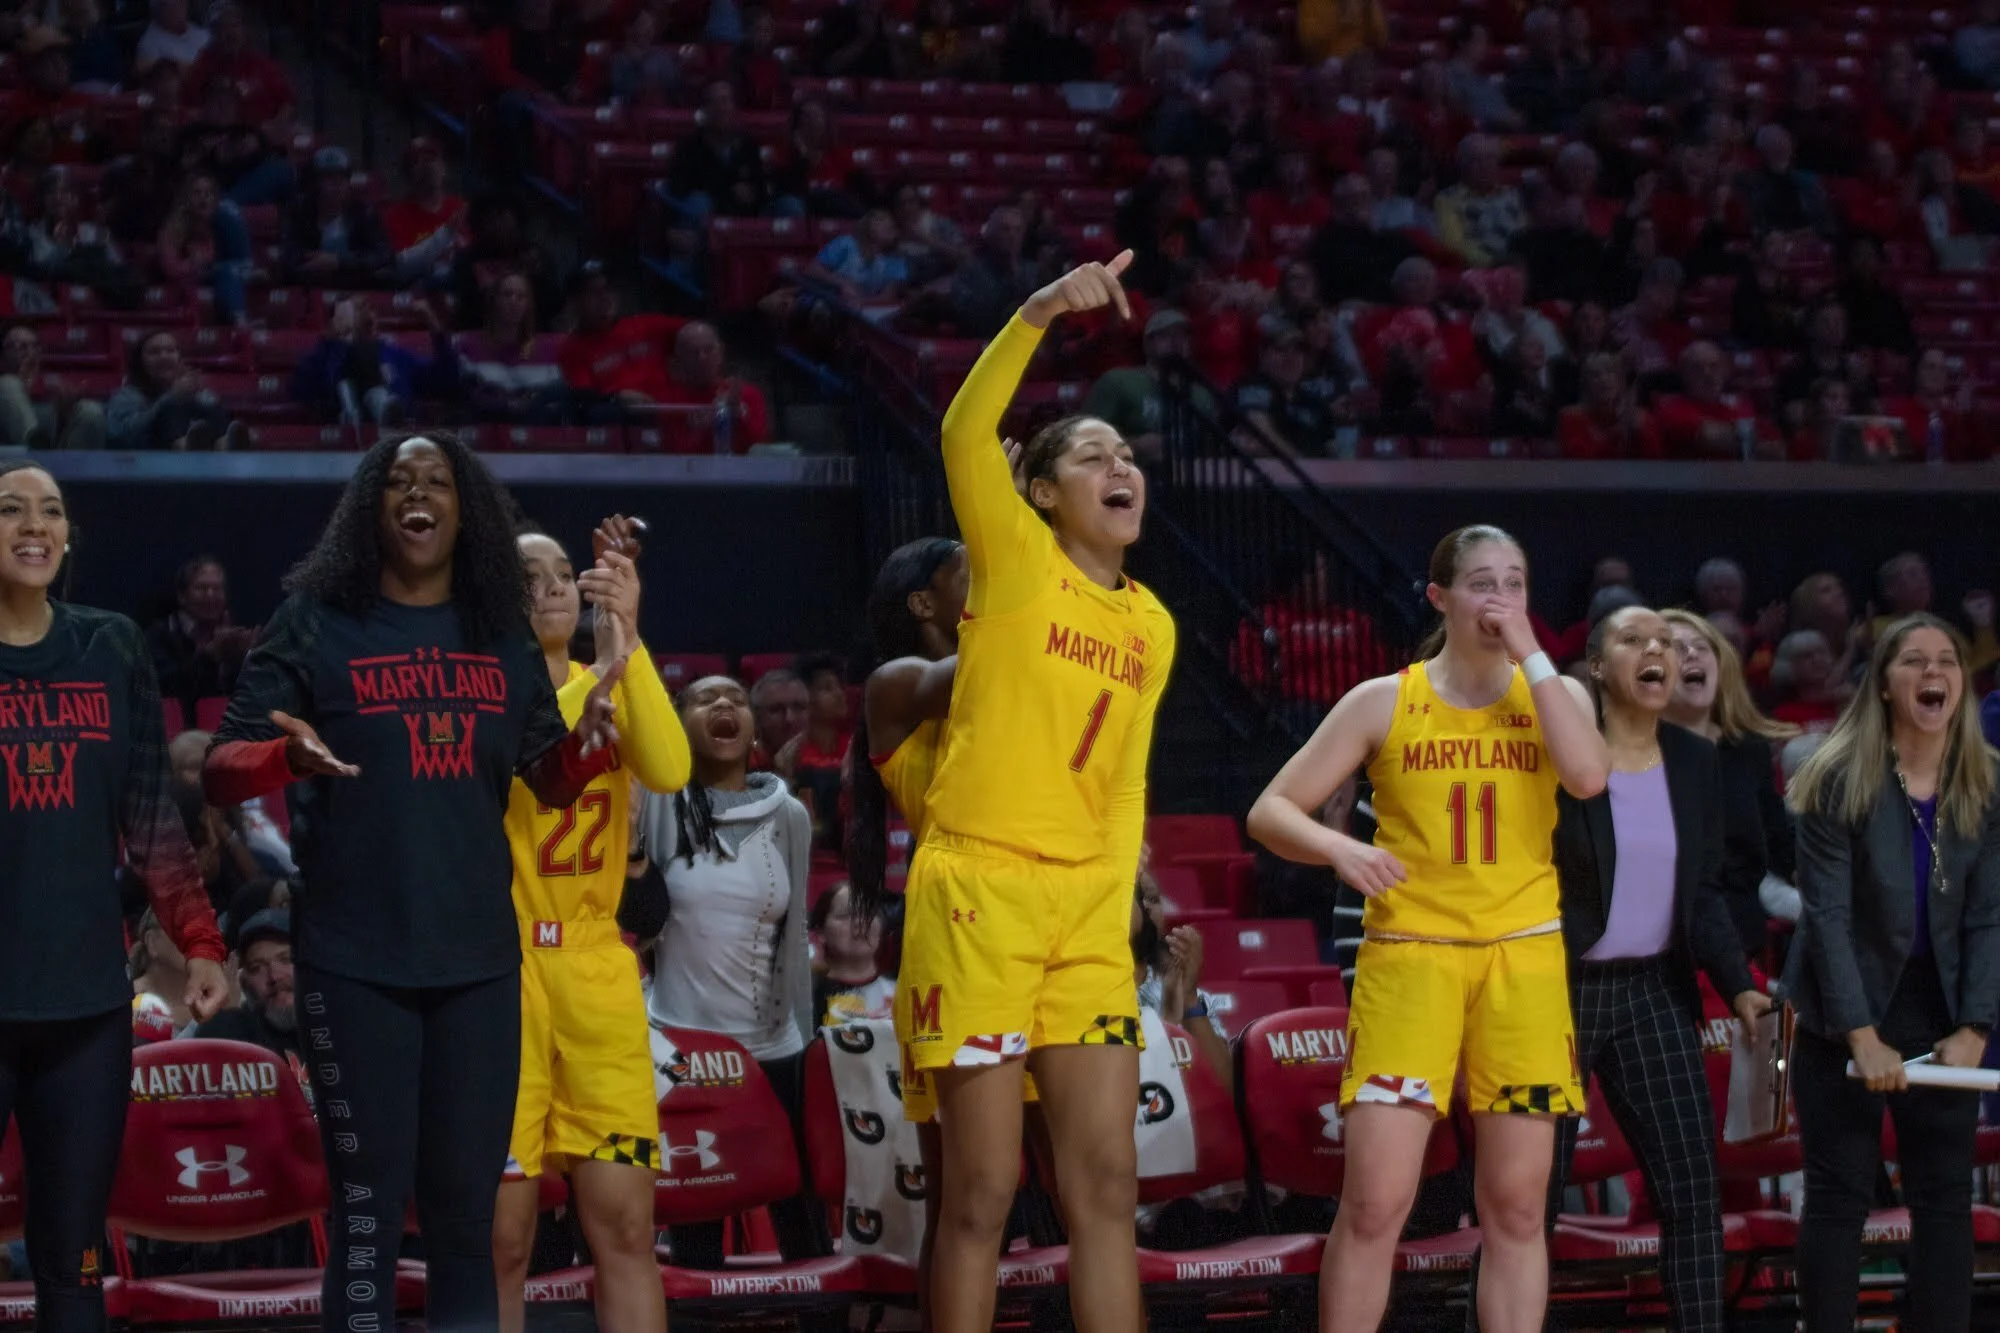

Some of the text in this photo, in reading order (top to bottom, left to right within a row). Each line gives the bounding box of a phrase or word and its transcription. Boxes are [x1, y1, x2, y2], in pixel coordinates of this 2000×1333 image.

[350, 663, 507, 705] MARYLAND
[1069, 689, 1113, 773] 1
[1402, 738, 1538, 773] MARYLAND
[536, 789, 610, 877] 22
[1446, 782, 1496, 864] 11
[538, 923, 558, 944] M
[909, 983, 943, 1036] M
[304, 992, 358, 1154] UNDER
[166, 1188, 267, 1204] UNDER ARMOUR
